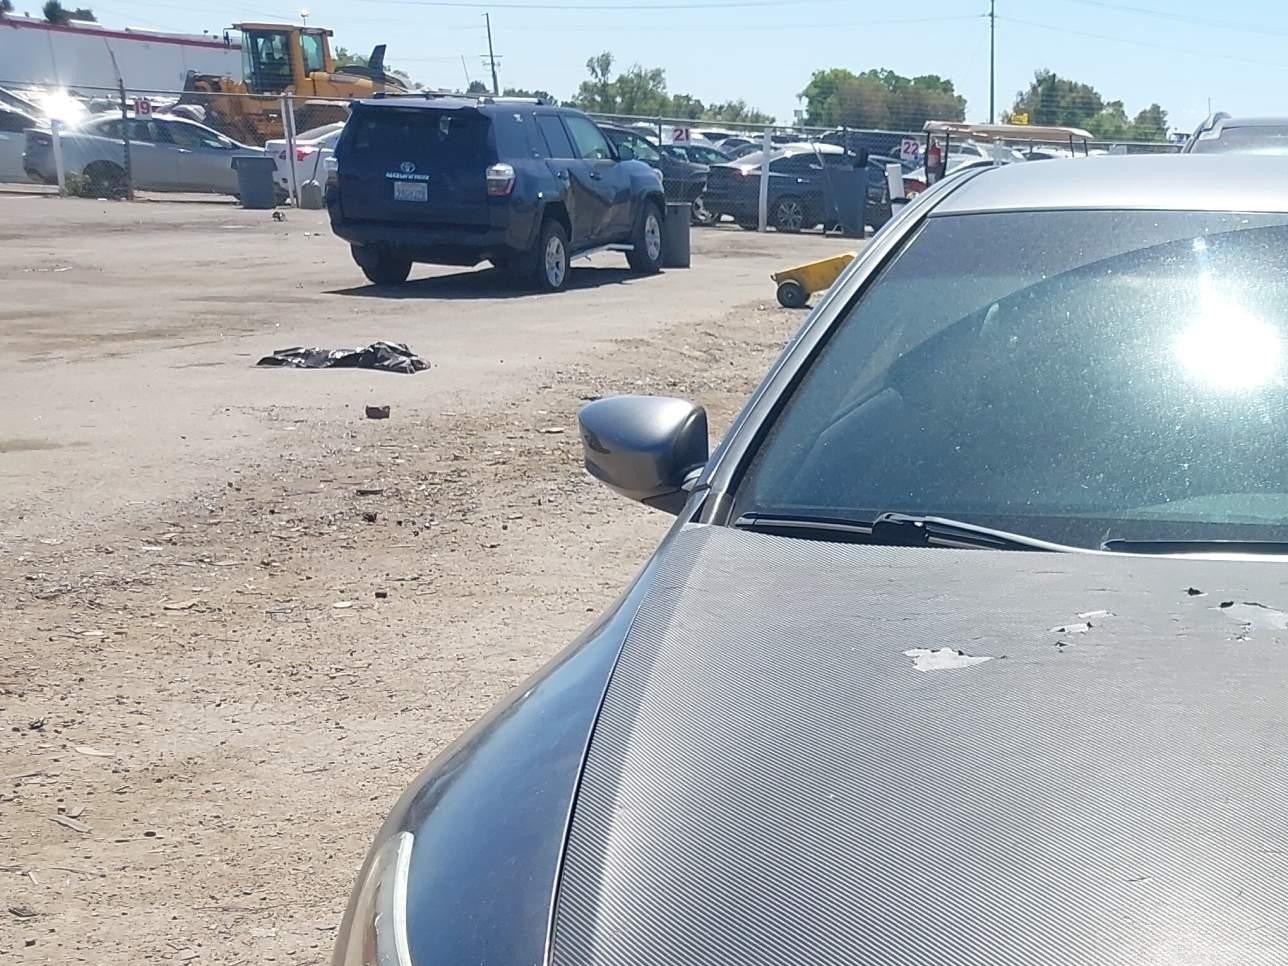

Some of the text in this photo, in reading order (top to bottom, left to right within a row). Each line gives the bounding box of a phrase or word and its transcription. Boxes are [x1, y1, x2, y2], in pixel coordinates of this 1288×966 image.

[134, 99, 151, 115] 19
[674, 128, 690, 142] 21
[903, 141, 919, 155] 22
